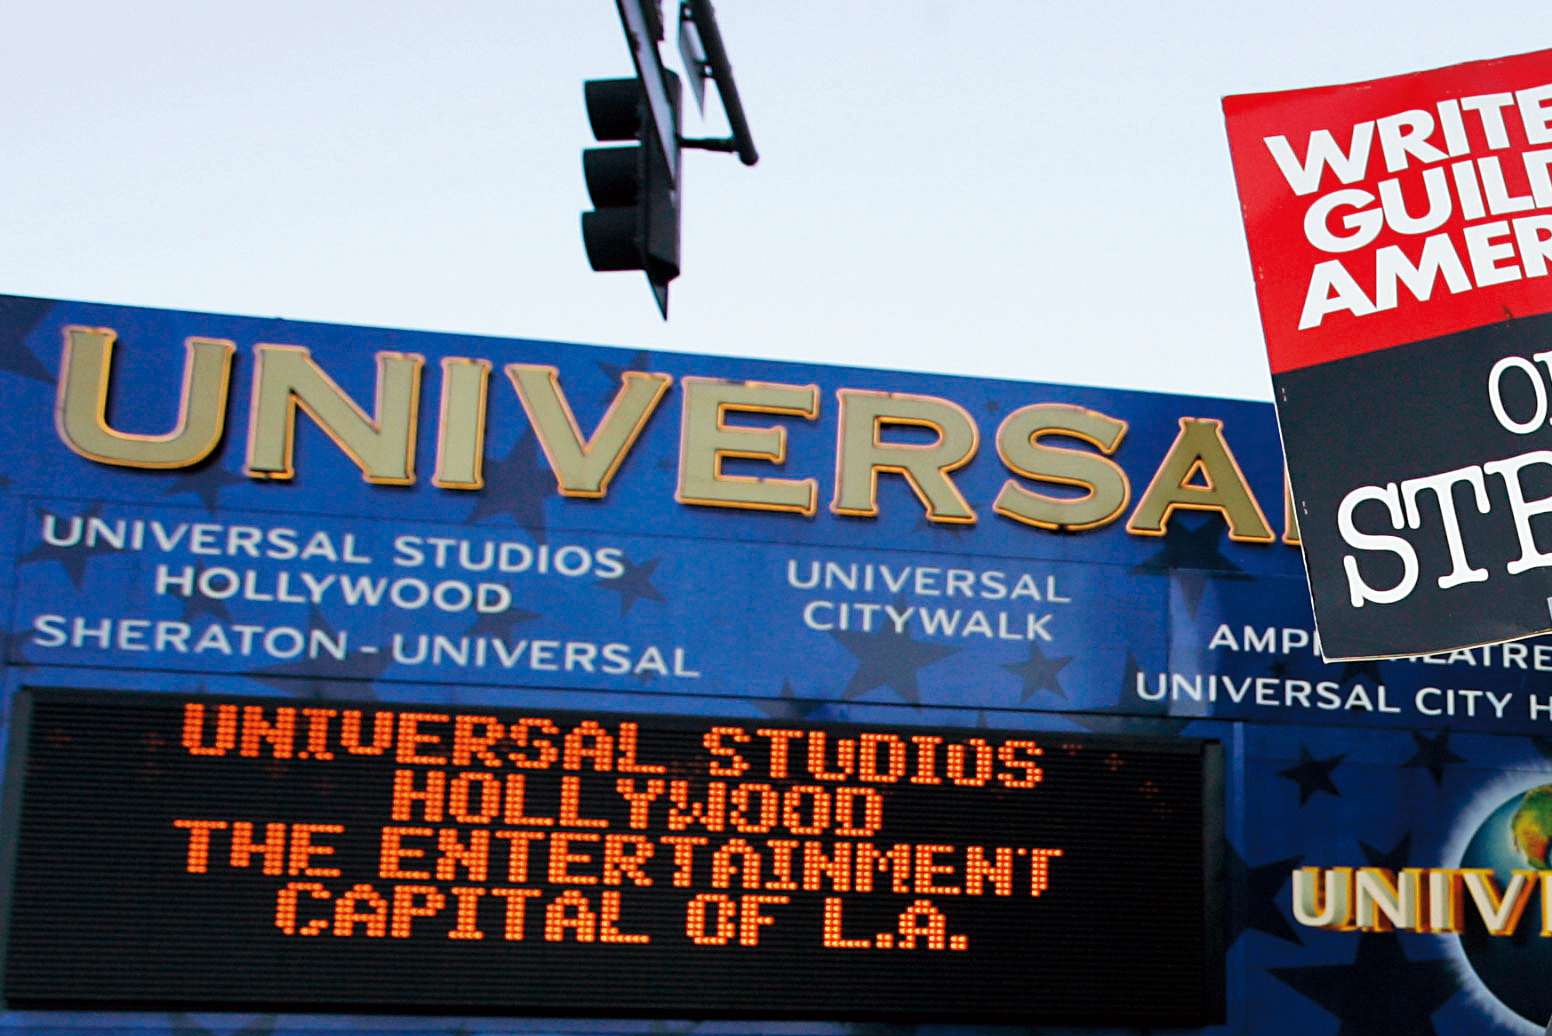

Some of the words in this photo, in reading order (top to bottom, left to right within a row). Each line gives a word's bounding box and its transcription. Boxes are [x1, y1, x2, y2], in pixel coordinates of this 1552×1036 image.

[56, 325, 1302, 546] UNIVERSA
[42, 515, 372, 563] UNIVERSAL
[393, 535, 626, 579] STUDIOS
[155, 564, 512, 614] HOLLYWOOD
[787, 559, 1071, 603] UNIVERSAL
[34, 615, 347, 661] SHERATON
[392, 634, 700, 678] UNIVERSAL
[803, 602, 1053, 642] CITYWALK
[1136, 672, 1401, 714] UNIVERSAL
[1415, 688, 1514, 718] CITY
[182, 703, 666, 772] UNIVERSAL
[703, 726, 1043, 788] STUDIOS
[392, 769, 882, 837] HOLLYWOOD
[173, 820, 344, 876] THE
[379, 826, 1063, 896] ENTERTAINMENT
[275, 882, 650, 943] CAPITAL
[686, 893, 790, 946] OF
[823, 897, 968, 950] L.A.
